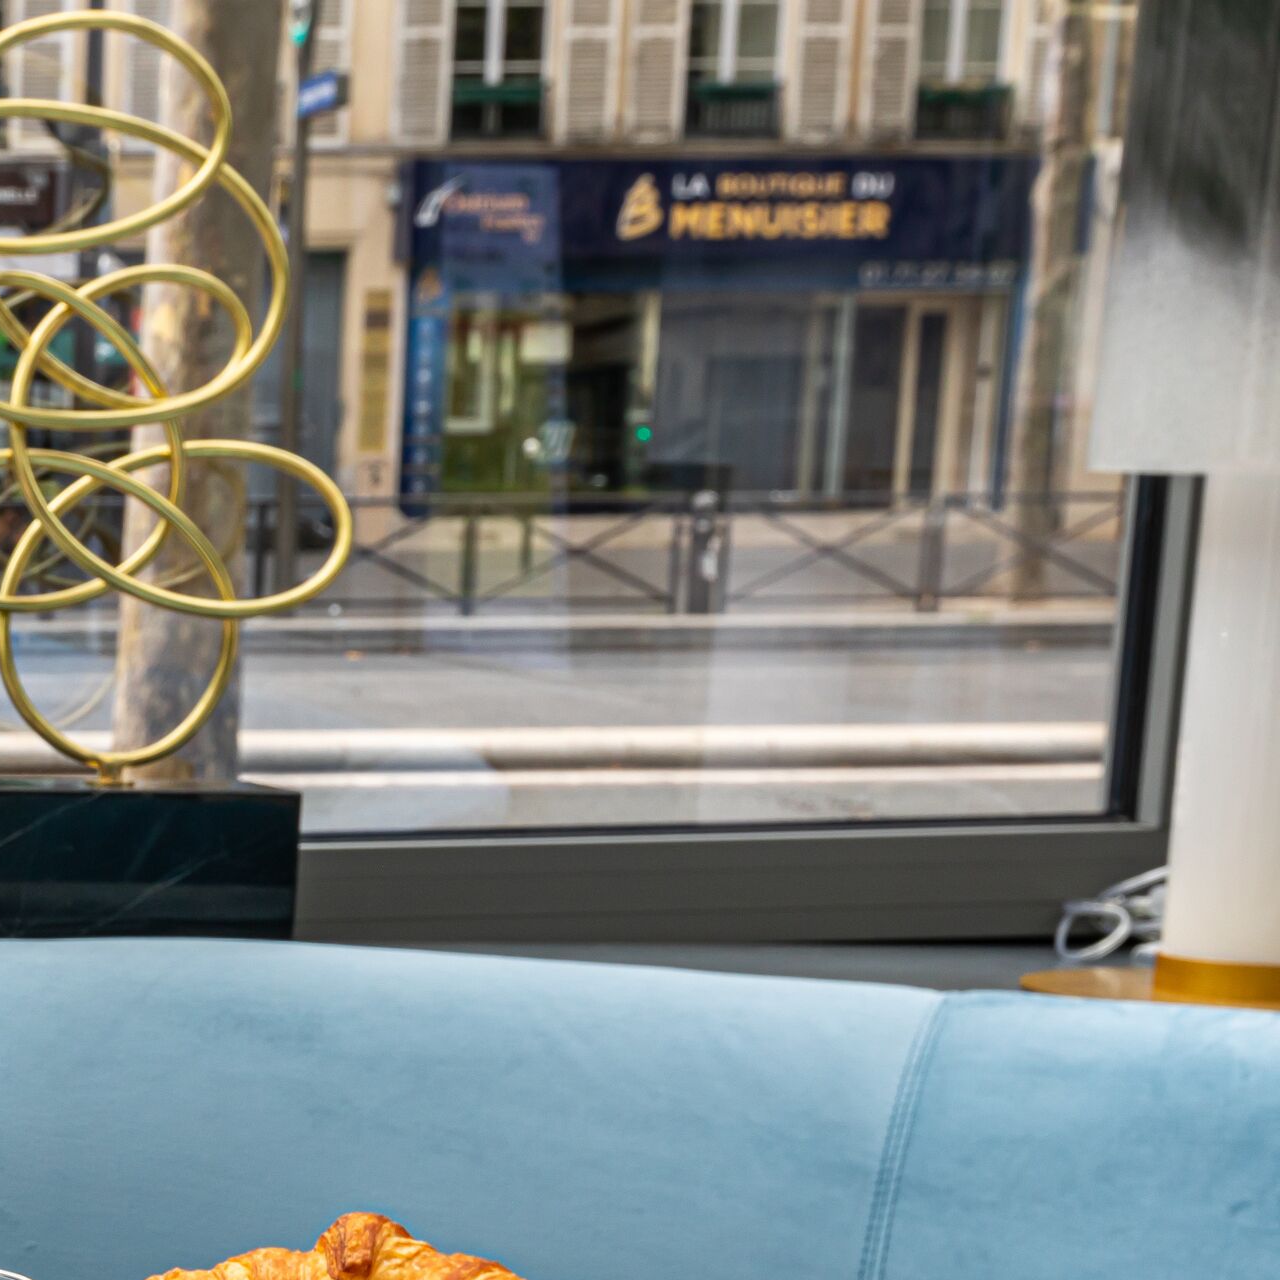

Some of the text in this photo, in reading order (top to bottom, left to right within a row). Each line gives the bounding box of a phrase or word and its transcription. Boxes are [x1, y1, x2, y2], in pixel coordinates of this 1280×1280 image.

[671, 171, 895, 199] LA BOUTIQUE DU
[668, 202, 891, 240] MENUISIER
